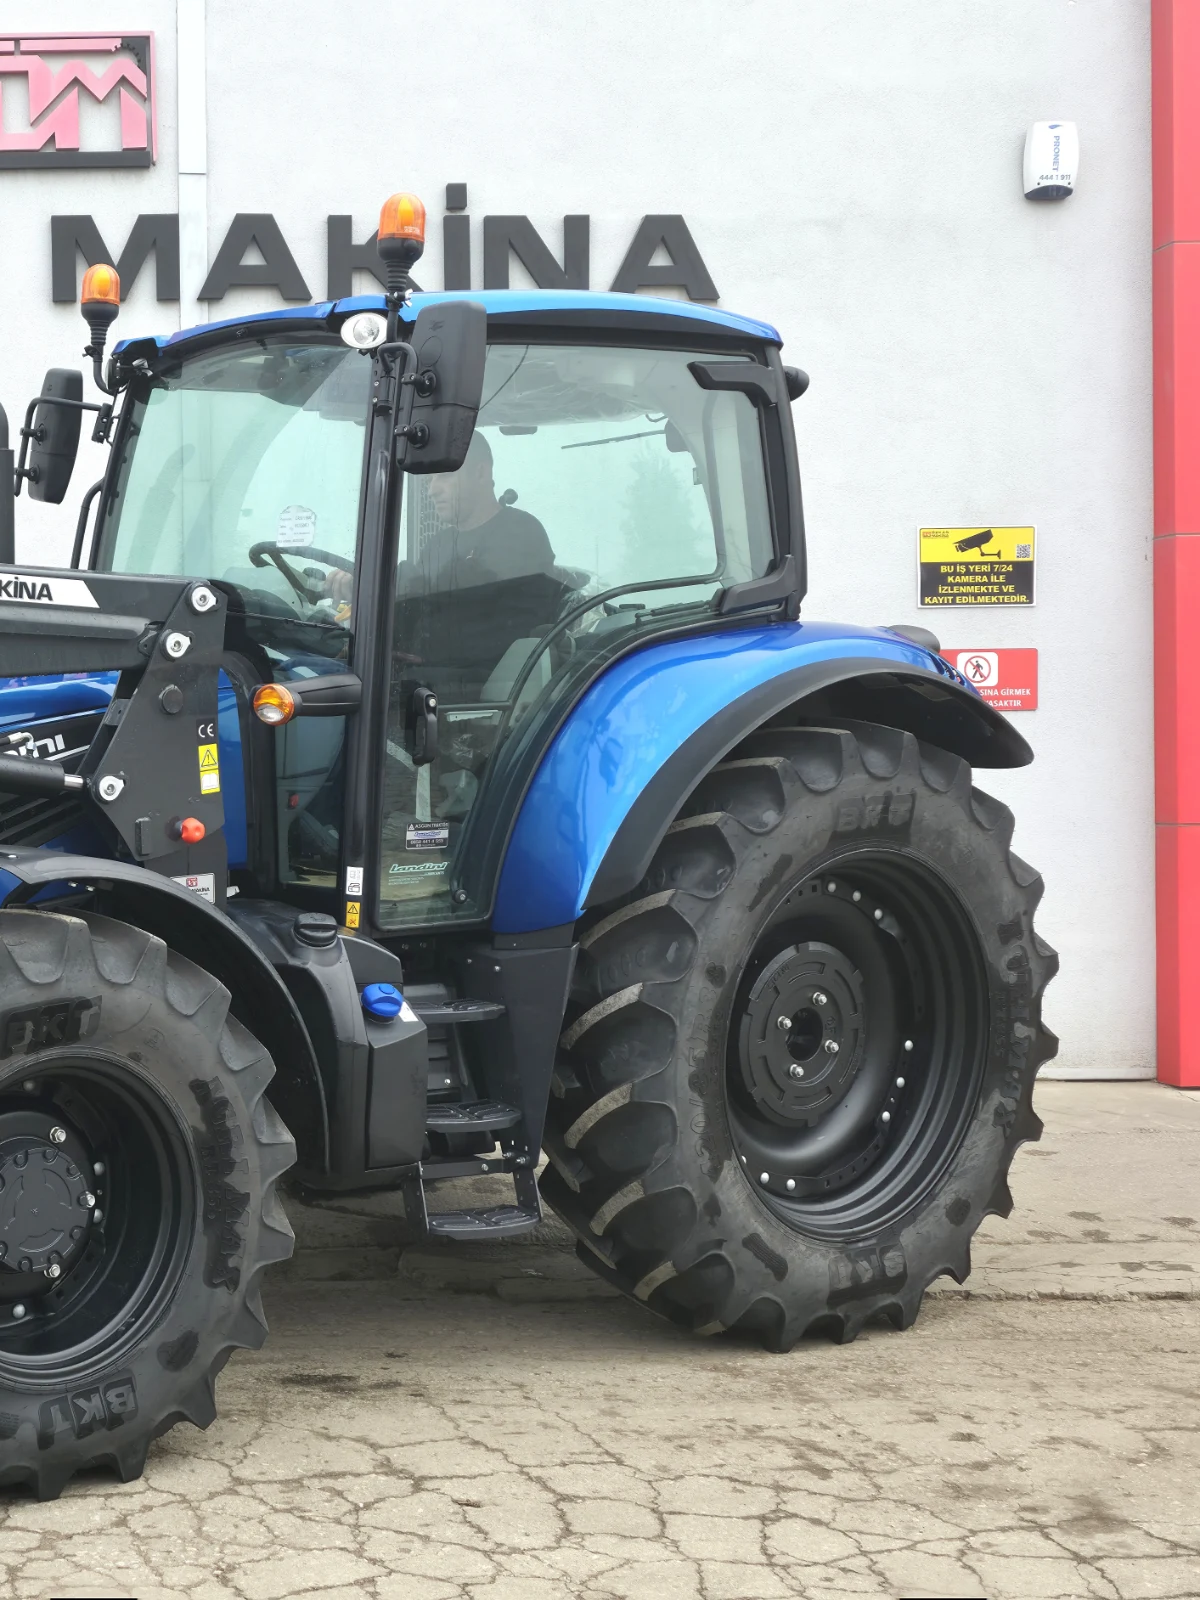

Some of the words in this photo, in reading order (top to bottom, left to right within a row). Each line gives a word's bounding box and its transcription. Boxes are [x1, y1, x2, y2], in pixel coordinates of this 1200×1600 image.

[1052, 135, 1061, 172] PRONET
[50, 183, 721, 304] MAKİNA
[940, 565, 954, 573] BU
[956, 563, 966, 574] İŞ
[969, 563, 991, 573] YERİ
[993, 564, 1013, 572] 7/24
[947, 575, 988, 583] KAMERA
[990, 574, 1006, 583] İLE
[938, 585, 1000, 594] İZLENMEKTE
[1002, 585, 1015, 593] VE
[924, 596, 953, 604] KAYIT
[956, 594, 1029, 604] EDİLMEKTEDİR.
[979, 688, 999, 696] SINA
[1000, 687, 1031, 696] GİRMEK
[987, 699, 1021, 707] ASAKTIR
[45, 1380, 138, 1438] BKT
